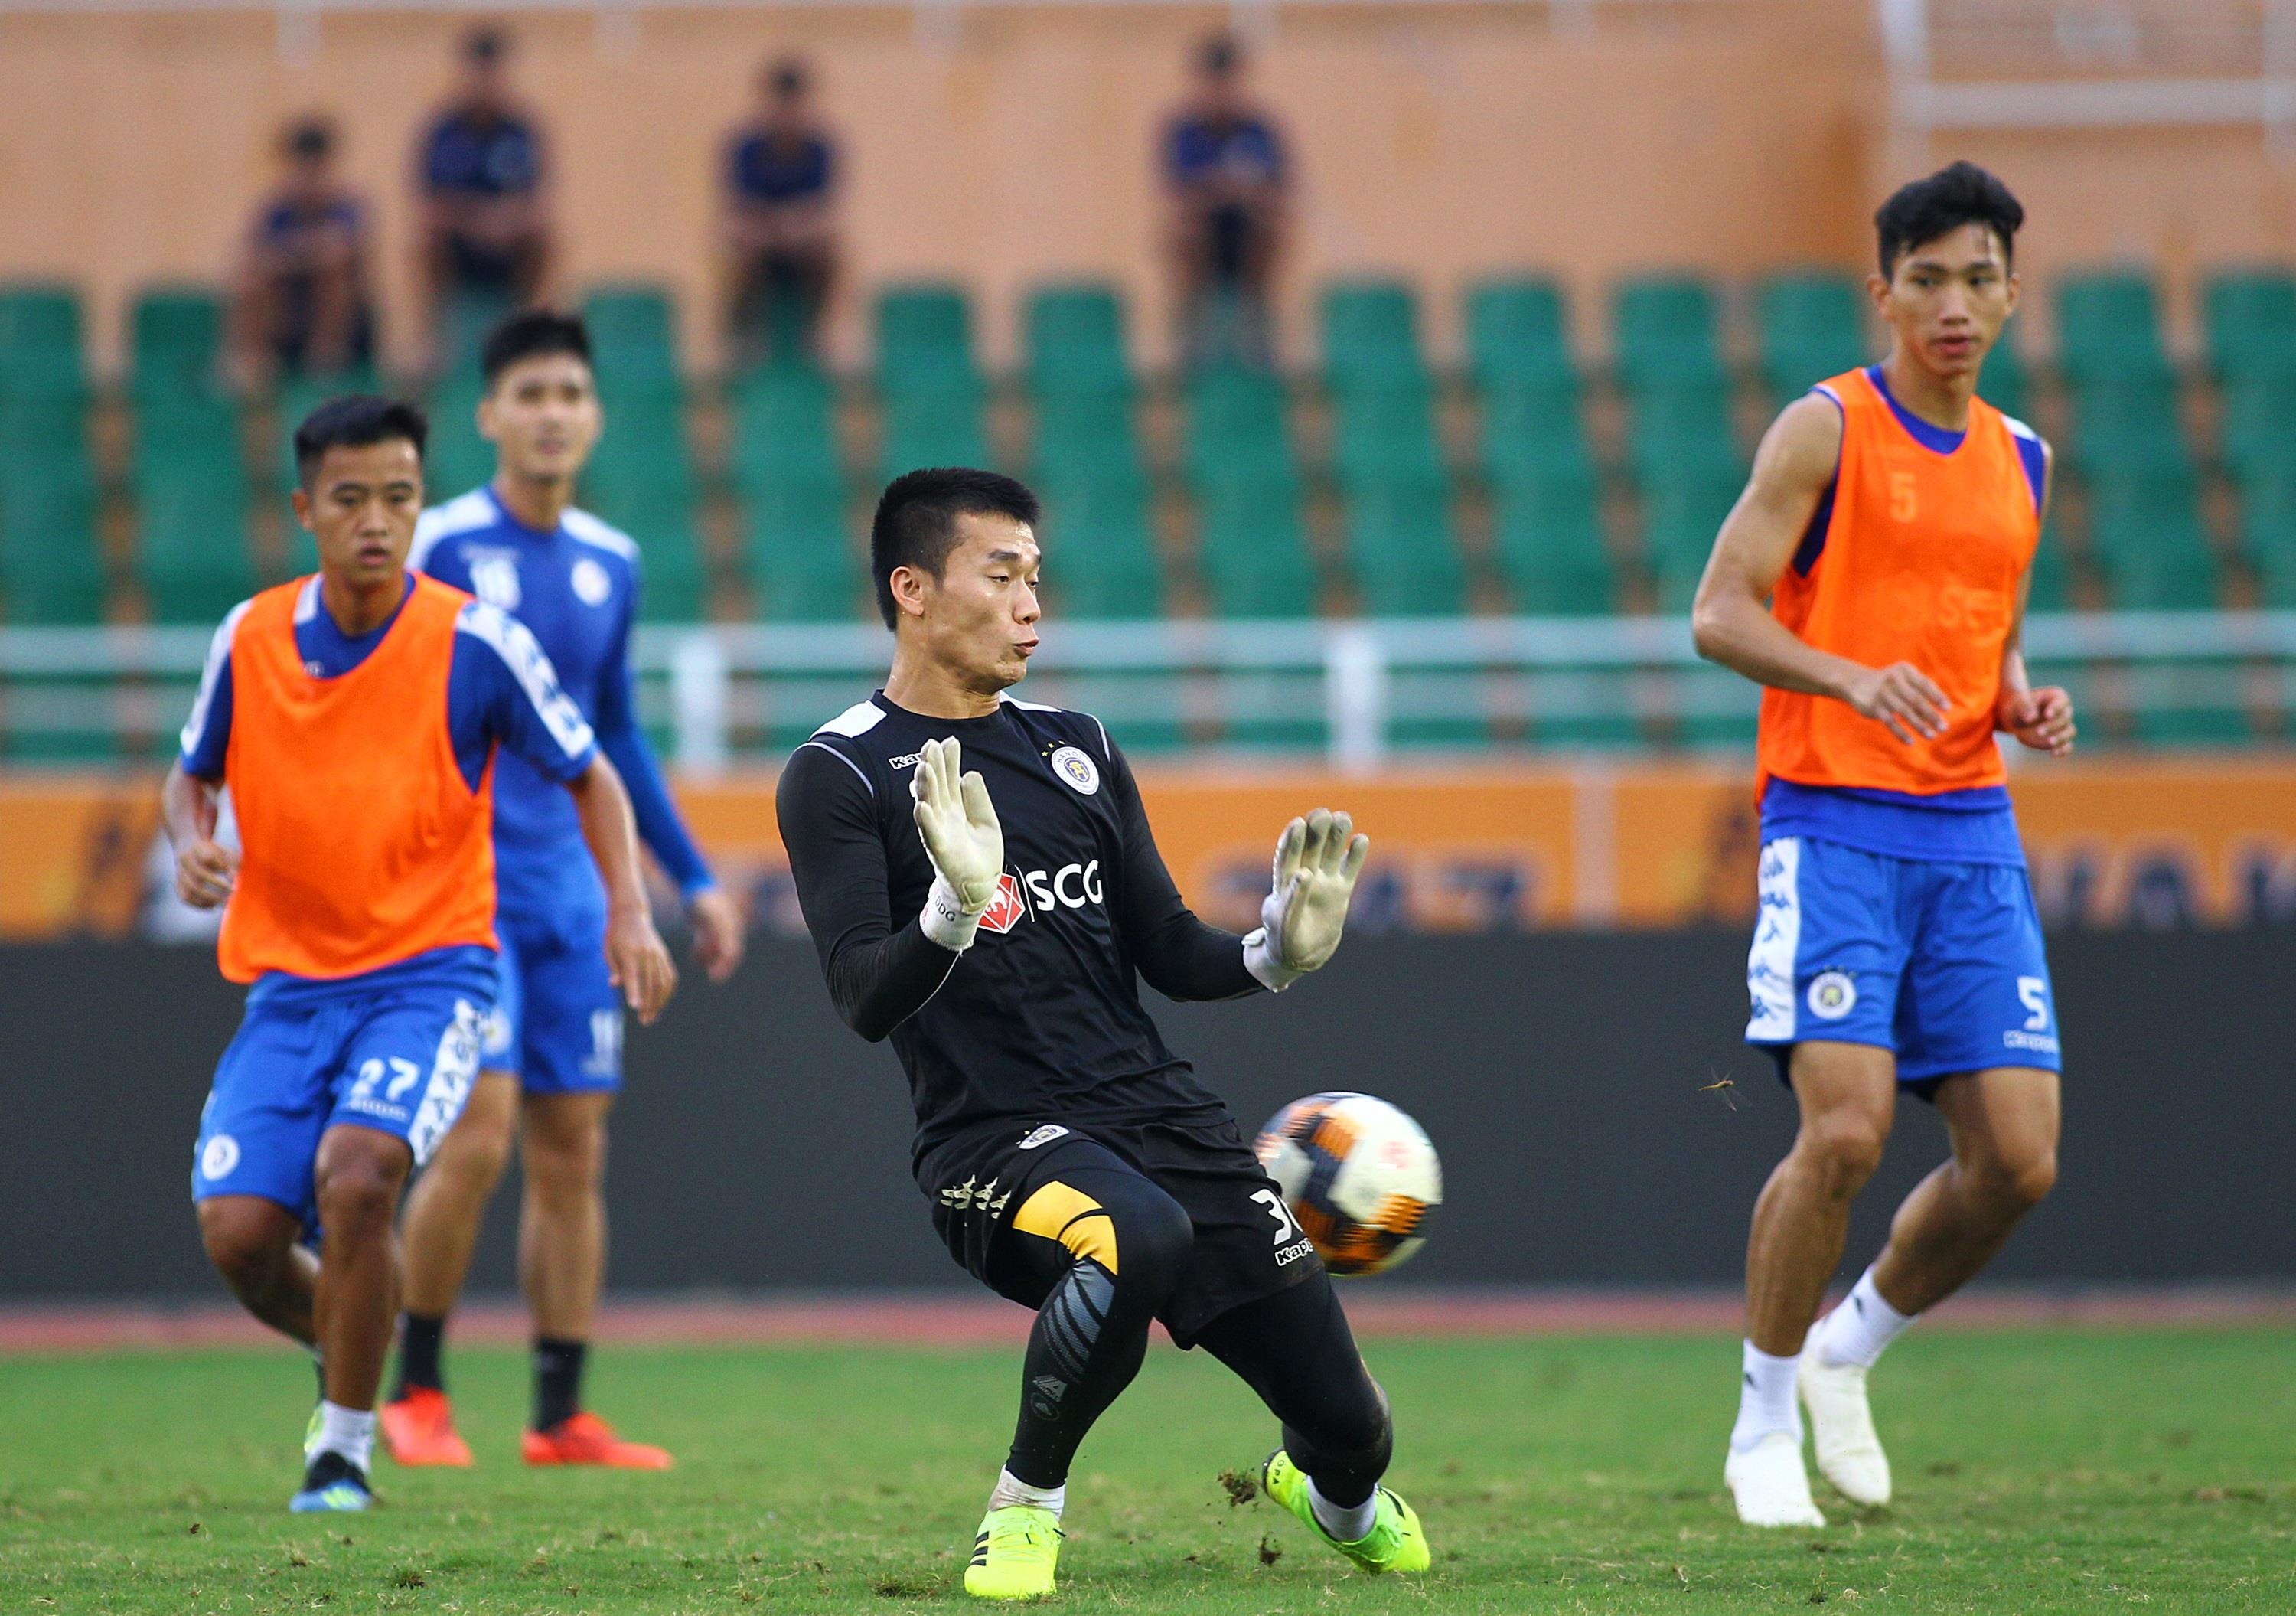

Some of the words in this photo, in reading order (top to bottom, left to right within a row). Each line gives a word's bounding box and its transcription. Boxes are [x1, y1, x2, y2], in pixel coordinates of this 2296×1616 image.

[889, 753, 921, 770] Ka
[1025, 859, 1103, 912] SCG
[2017, 976, 2048, 1031] 5
[351, 1056, 420, 1104] 27
[1249, 1189, 1303, 1245] 3
[1275, 1238, 1314, 1266] Kap
